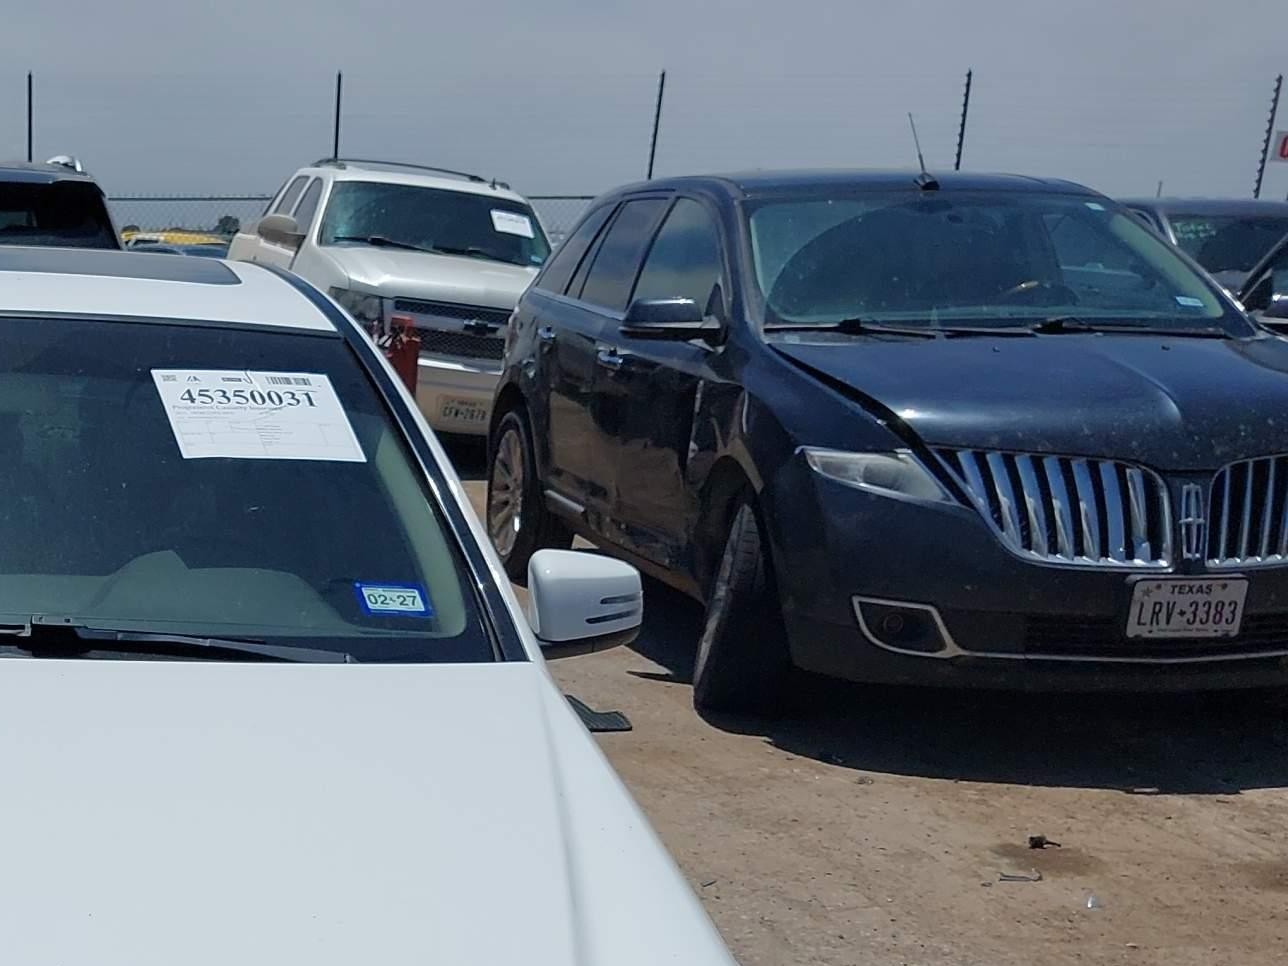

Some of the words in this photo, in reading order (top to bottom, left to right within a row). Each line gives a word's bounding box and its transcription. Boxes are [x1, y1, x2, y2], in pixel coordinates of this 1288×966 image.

[180, 388, 318, 408] 45350031
[1170, 584, 1213, 595] TEXAS
[367, 593, 418, 606] 02-27
